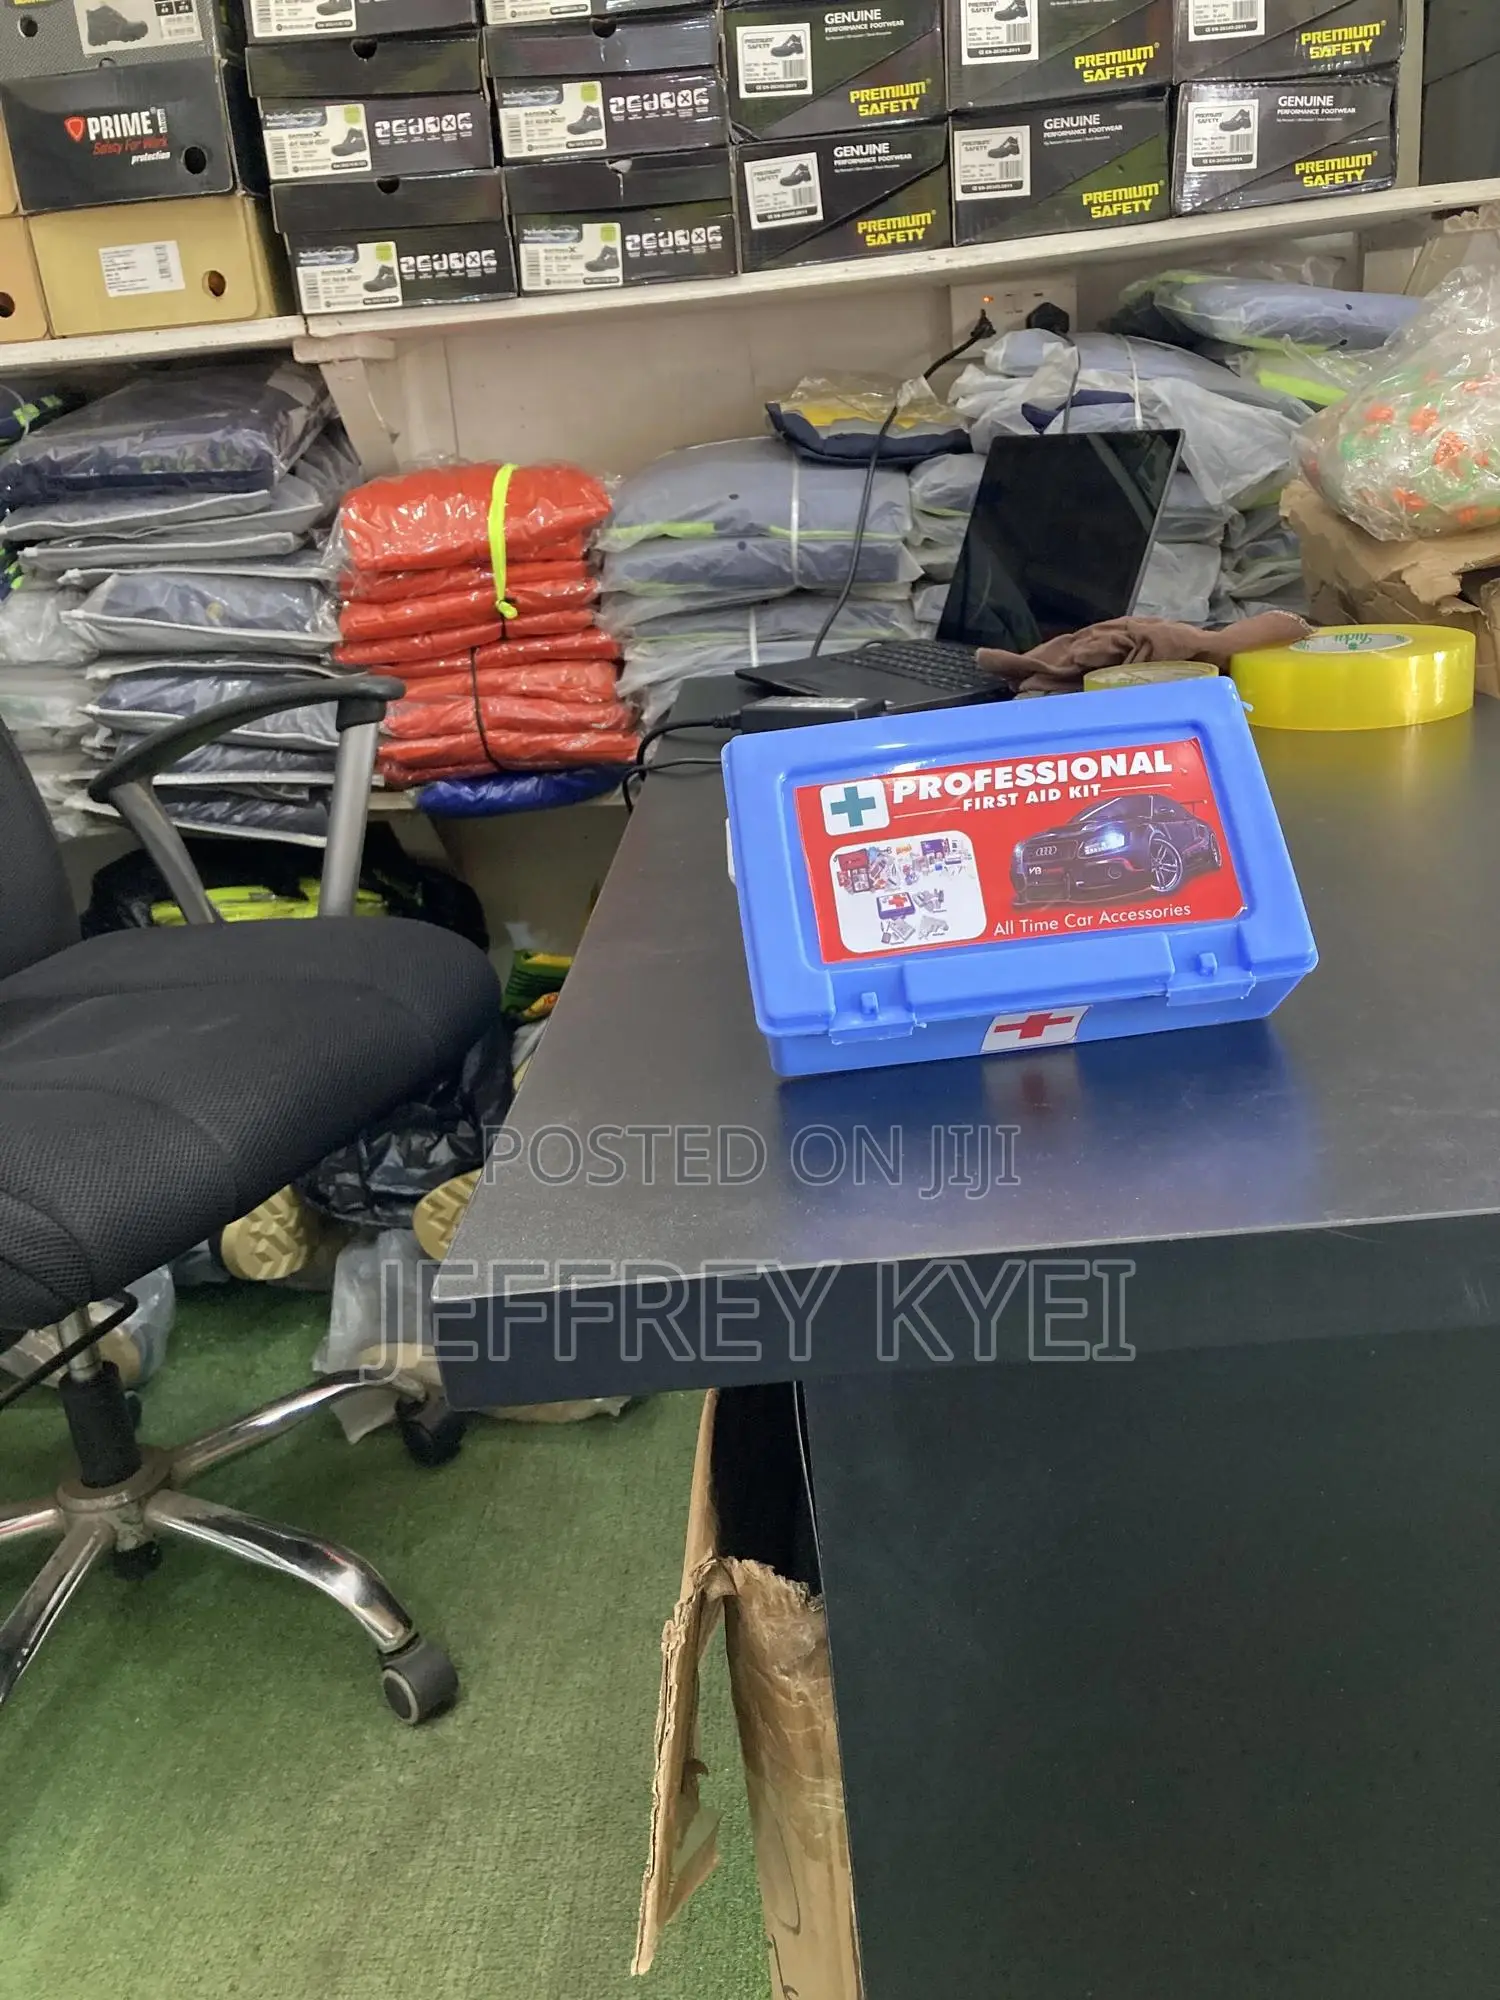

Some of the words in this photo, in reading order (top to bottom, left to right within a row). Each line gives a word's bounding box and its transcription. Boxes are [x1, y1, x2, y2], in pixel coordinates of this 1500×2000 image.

[824, 8, 882, 24] GENUINE
[824, 23, 868, 33] PERFORMANCE
[870, 20, 905, 29] FOOTWEAR
[1300, 23, 1381, 46] PREMIUM
[1074, 45, 1154, 70] PREMIUM
[1309, 39, 1373, 60] SAFETY
[1083, 62, 1147, 83] SAFETY
[849, 81, 926, 104] PREMIUM
[1278, 95, 1334, 107] GENUINE
[858, 97, 920, 117] SAFETY
[86, 111, 153, 141] PRIME
[1043, 113, 1100, 130] GENUINE
[1043, 128, 1087, 138] PERFORMANCE
[1088, 124, 1123, 134] FOOTWEAR
[131, 150, 171, 165] protection
[833, 142, 890, 157] GENUINE
[834, 156, 877, 166] PERFORMANCE
[878, 153, 913, 162] FOOTWEAR
[1294, 153, 1372, 175] PREMIUM
[1302, 168, 1366, 188] SAFETY
[1082, 182, 1159, 206] PREMIUM
[1090, 198, 1153, 219] SAFETY
[857, 212, 932, 234] PREMIUM
[865, 227, 926, 247] SAFETY
[892, 749, 1173, 804] PROFESSIONAL
[962, 792, 1019, 813] FIRST
[1025, 787, 1061, 805] AID
[1069, 783, 1101, 799] KIT
[993, 918, 1014, 937] All
[1019, 918, 1059, 934] Time
[1064, 913, 1094, 929] Car
[1098, 903, 1192, 925] Accessories
